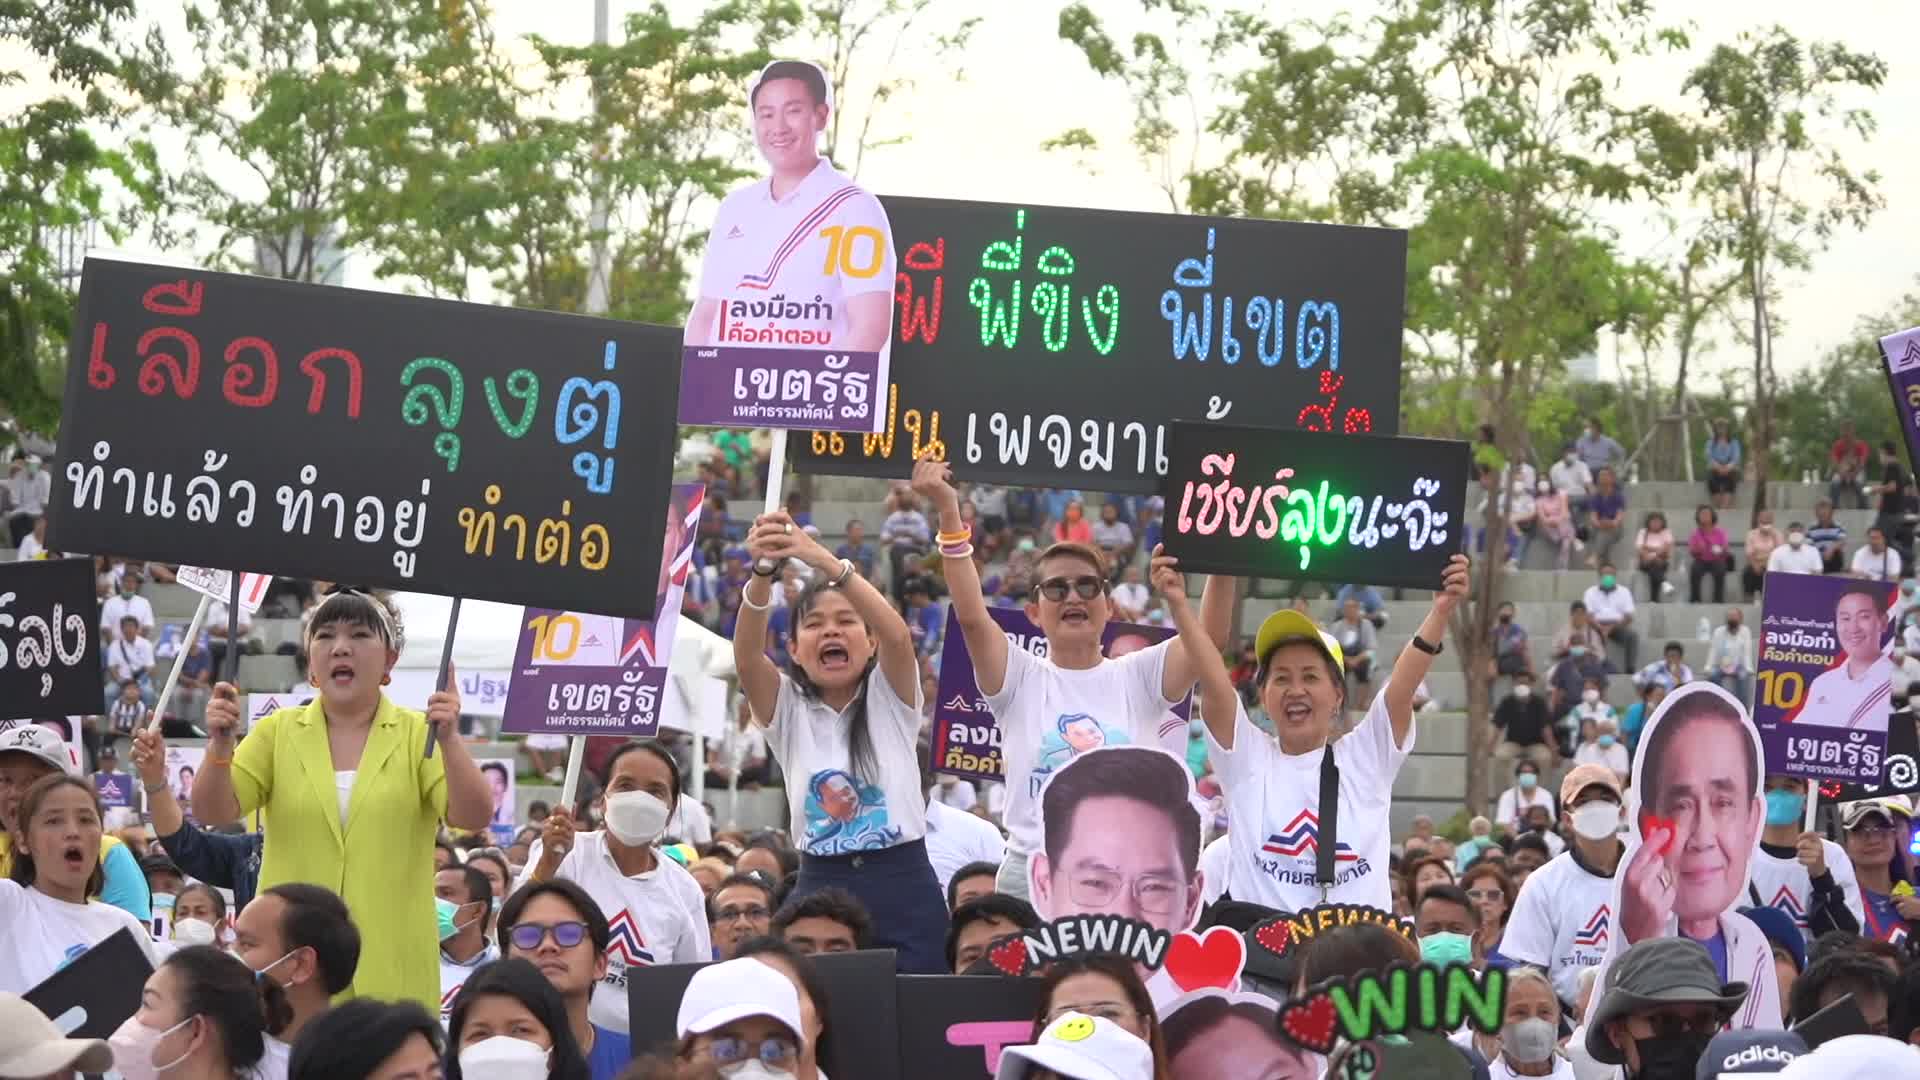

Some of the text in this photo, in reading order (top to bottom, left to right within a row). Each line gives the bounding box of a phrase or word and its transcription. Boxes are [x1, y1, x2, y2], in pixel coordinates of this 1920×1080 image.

[819, 225, 886, 279] 10
[729, 294, 834, 322] ลงมือทำ
[969, 209, 1120, 355] พี่ขิง
[1160, 227, 1340, 371] พี่เขต
[727, 323, 832, 346] คือคำตอบ
[88, 280, 622, 495] เลือก ลุงตู่
[733, 355, 871, 419] เขตรัฐ
[732, 402, 834, 421] เหล่าธรรมทัศน์
[65, 440, 611, 578] ทำแล้ว ทำอยู่ ทำต่อ
[527, 614, 582, 662] 10
[547, 671, 658, 726] เขตรัฐ
[1757, 669, 1804, 709] 10
[1786, 731, 1881, 777] เขตรัฐ
[1023, 920, 1168, 967] NEWIN
[1331, 968, 1505, 1040] WIN
[1723, 1045, 1796, 1069] adida
